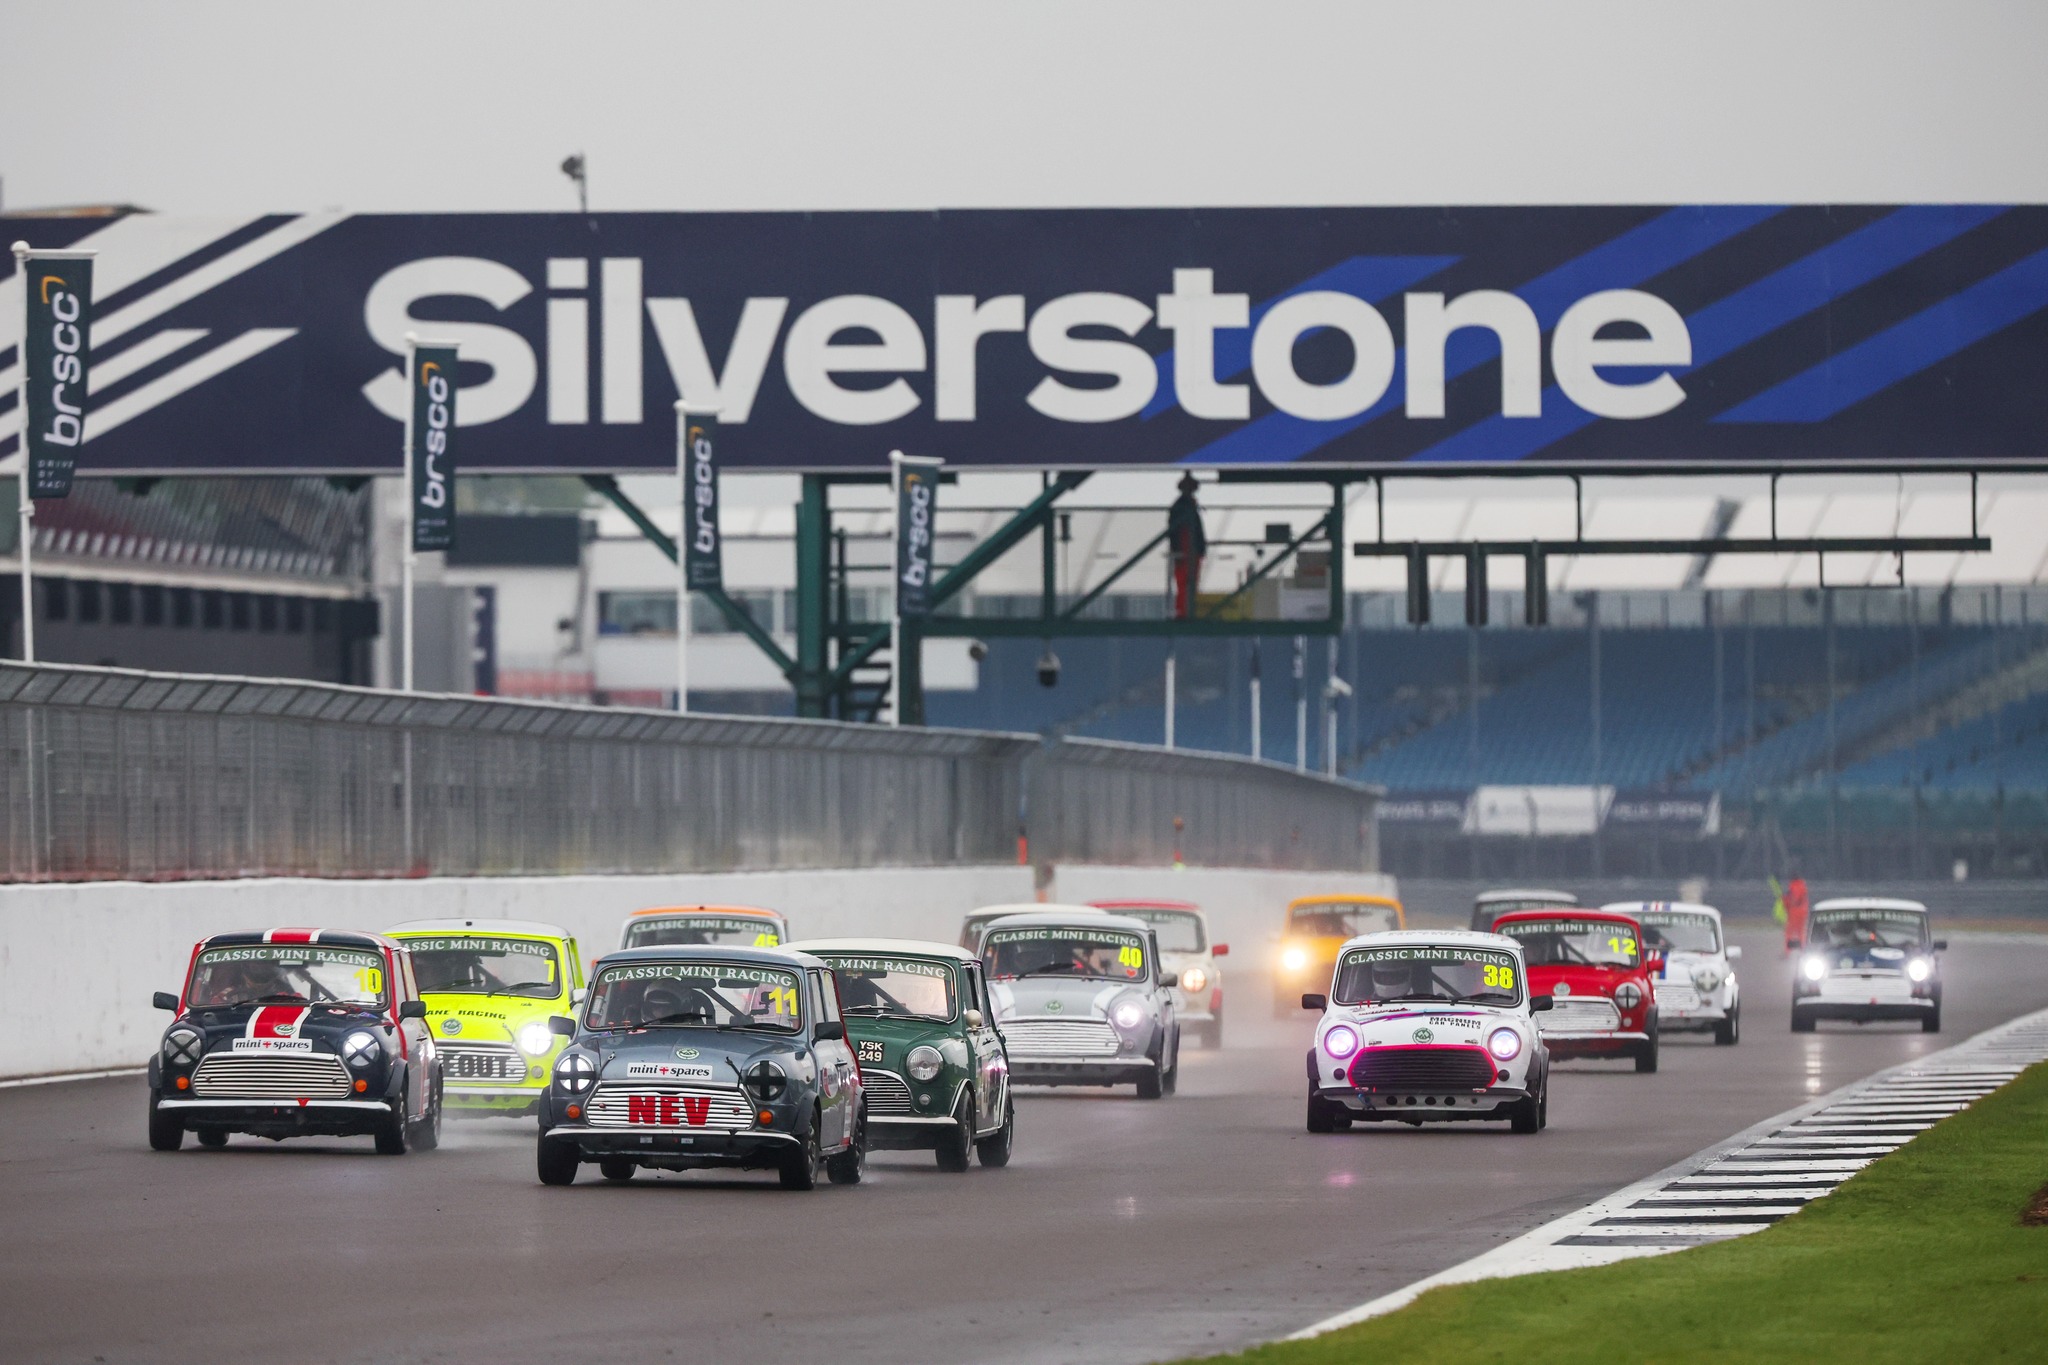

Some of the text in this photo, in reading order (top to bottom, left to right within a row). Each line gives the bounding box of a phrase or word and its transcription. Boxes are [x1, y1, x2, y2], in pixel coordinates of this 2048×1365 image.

[362, 256, 1693, 426] Silverstone
[43, 291, 82, 447] brscc
[420, 375, 449, 509] brscc
[692, 438, 715, 553] brscc
[901, 484, 930, 587] brscc
[633, 919, 774, 934] CLASSIC MINI RACING
[1502, 923, 1632, 937] CLASSIC MINI RACING
[753, 933, 779, 948] 45
[993, 930, 1139, 947] CLASSIC MINI RACING
[1607, 937, 1637, 956] 12
[402, 940, 550, 957] ASSIC MINI RACING
[1118, 946, 1142, 969] 40
[203, 949, 378, 967] CLASSIC MINI RACING
[1348, 950, 1509, 966] CLASSIC MINI RACING
[543, 959, 556, 983] 7
[604, 966, 792, 987] CLASSIC MINI RACING
[838, 959, 878, 970] MINI
[883, 961, 946, 978] RACING
[1483, 964, 1514, 990] 38
[353, 967, 383, 995] 10
[768, 986, 798, 1016] 11
[458, 1010, 506, 1019] RACING
[1430, 1016, 1481, 1025] MAGNUM
[1450, 1022, 1481, 1030] PANELS
[235, 1039, 310, 1050] mini spares
[859, 1040, 885, 1052] YSK
[442, 1052, 512, 1077] EOUT
[858, 1050, 883, 1063] 249
[629, 1064, 710, 1077] mini spares
